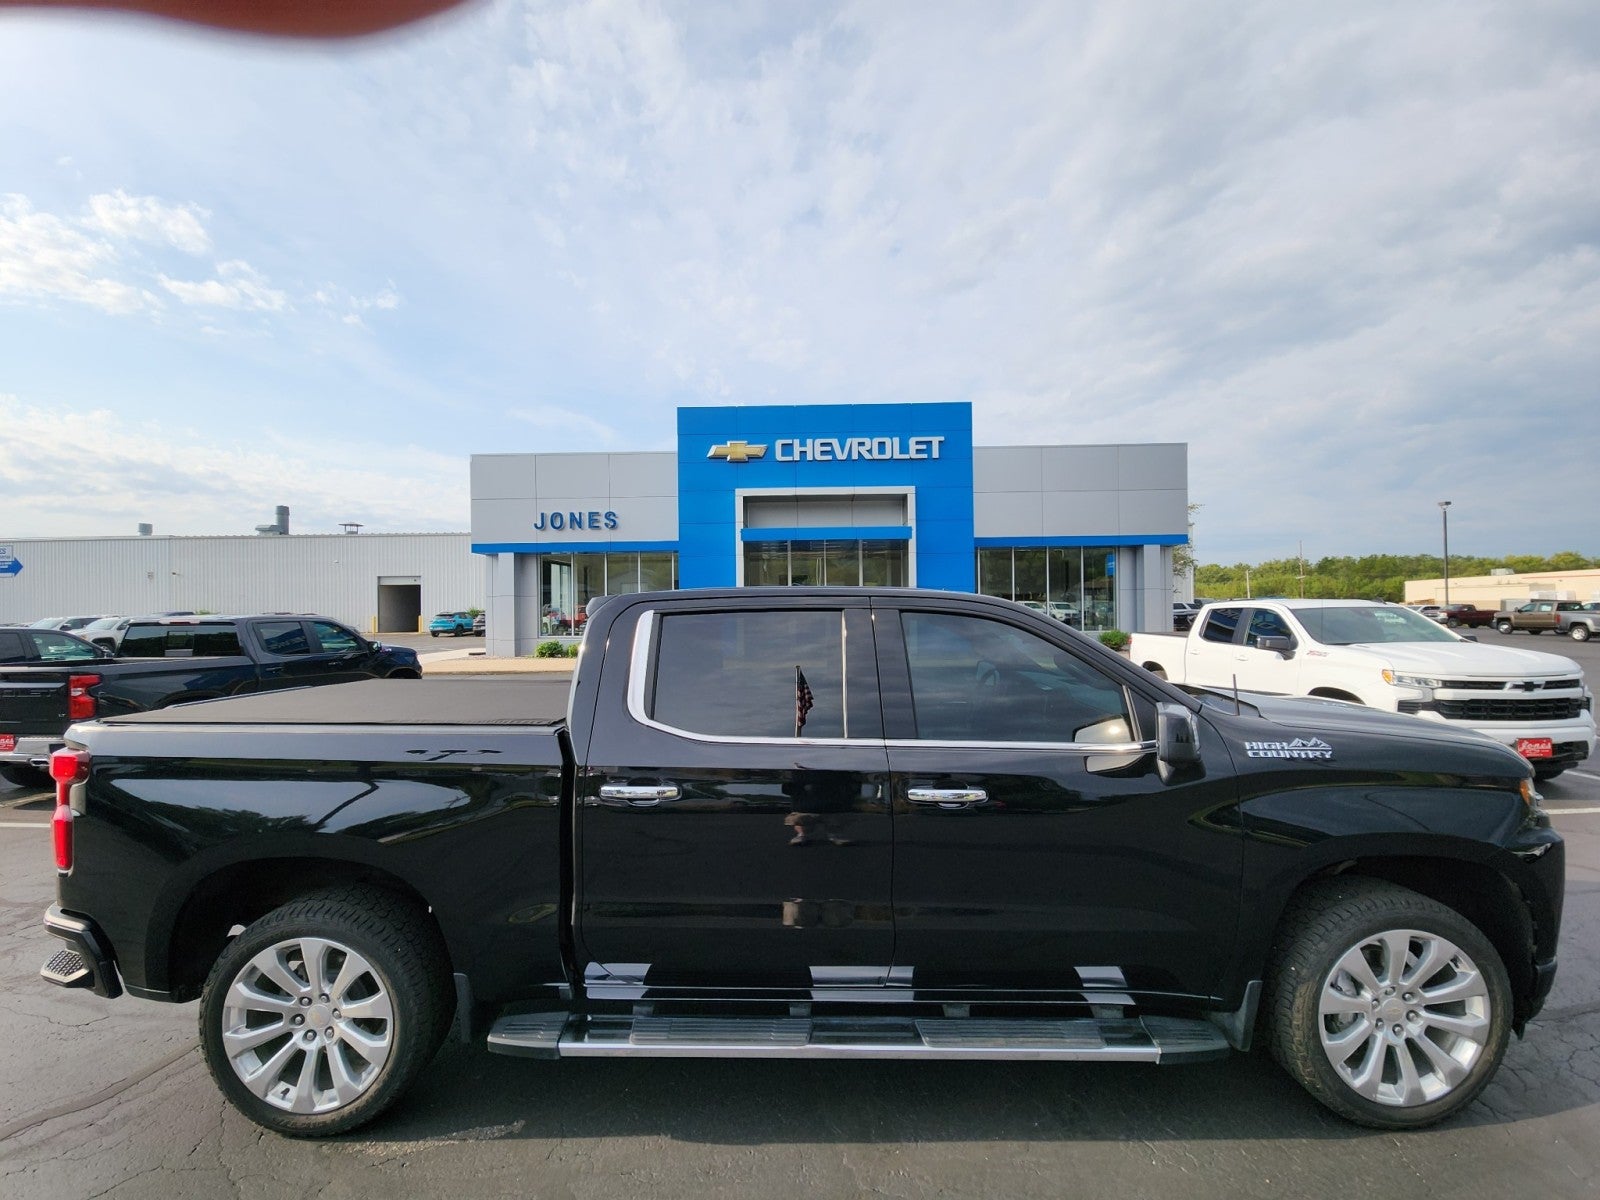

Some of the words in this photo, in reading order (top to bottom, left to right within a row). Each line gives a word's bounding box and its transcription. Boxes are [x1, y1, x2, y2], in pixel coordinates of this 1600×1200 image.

[775, 436, 945, 461] CHEVROLET
[533, 511, 618, 530] JONES
[1244, 741, 1289, 750] HIGH
[1246, 750, 1333, 759] COUNTRY
